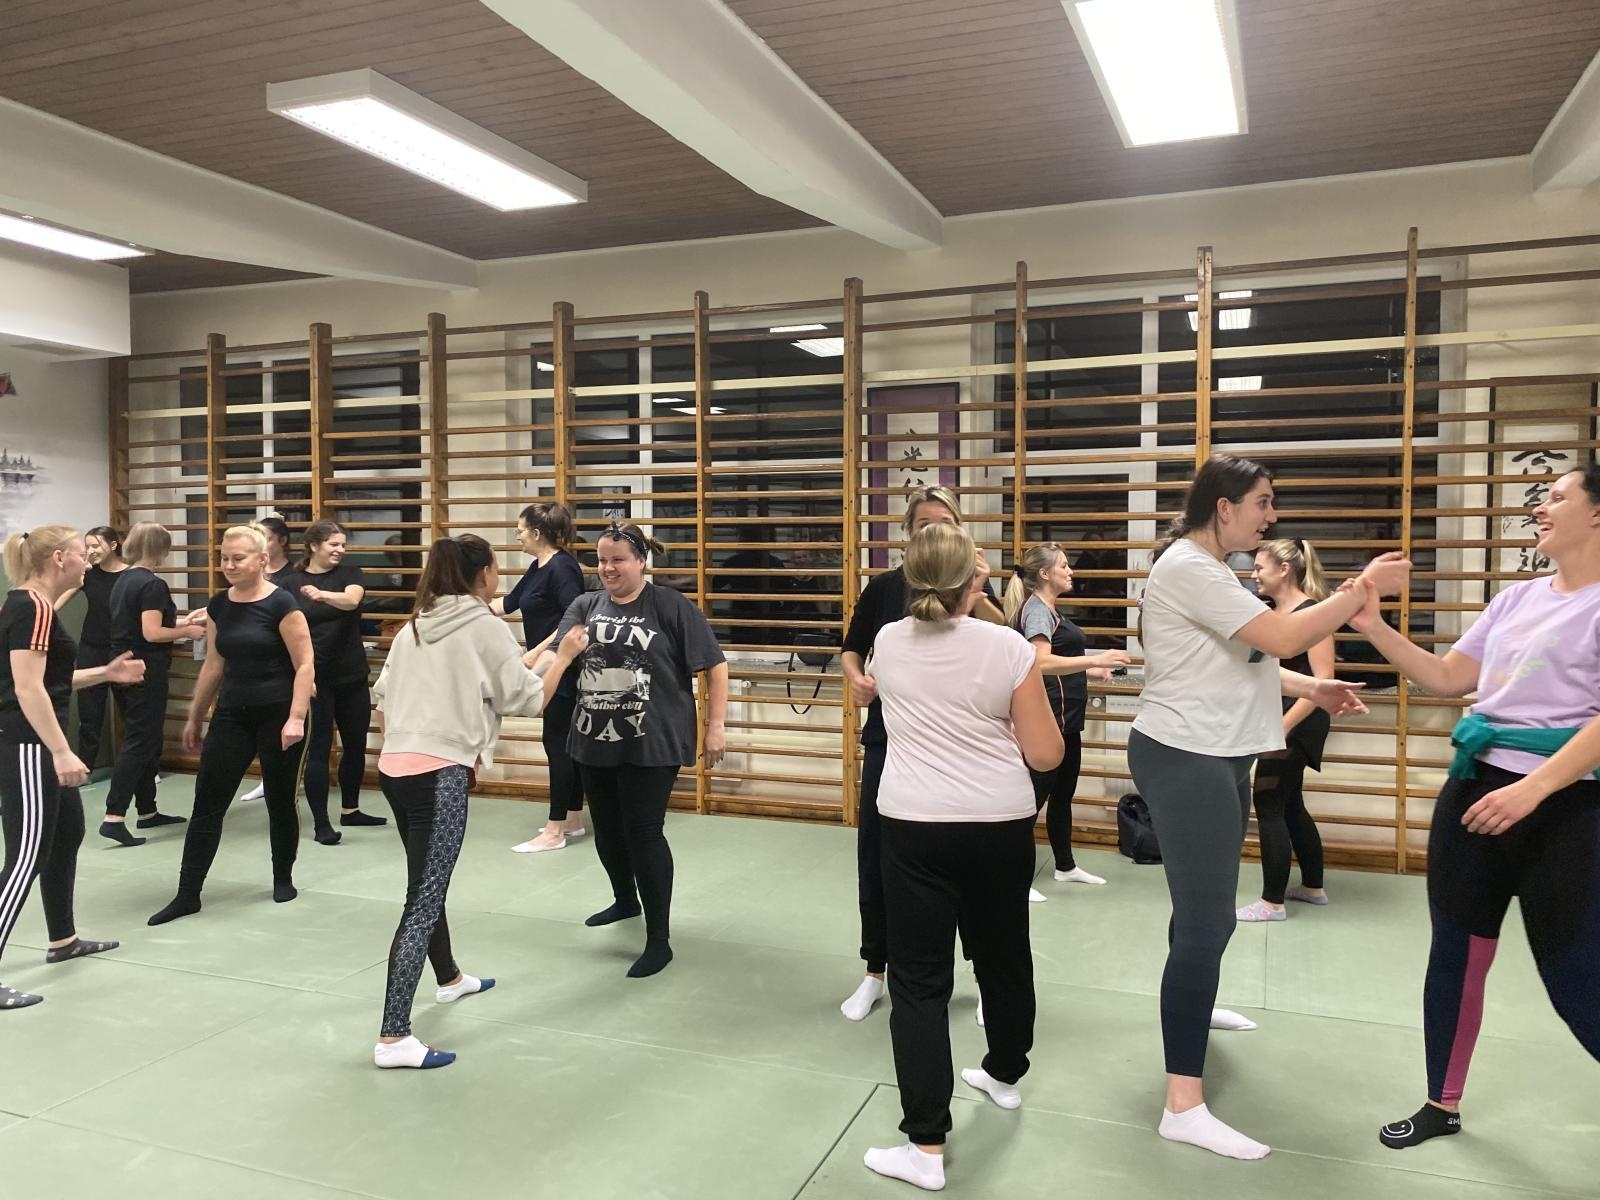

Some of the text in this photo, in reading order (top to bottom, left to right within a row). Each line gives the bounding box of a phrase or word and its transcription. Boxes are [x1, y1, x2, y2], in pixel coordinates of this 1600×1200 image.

[628, 615, 646, 624] the
[584, 622, 658, 651] UN
[621, 701, 644, 711] chill
[576, 708, 646, 742] DAY
